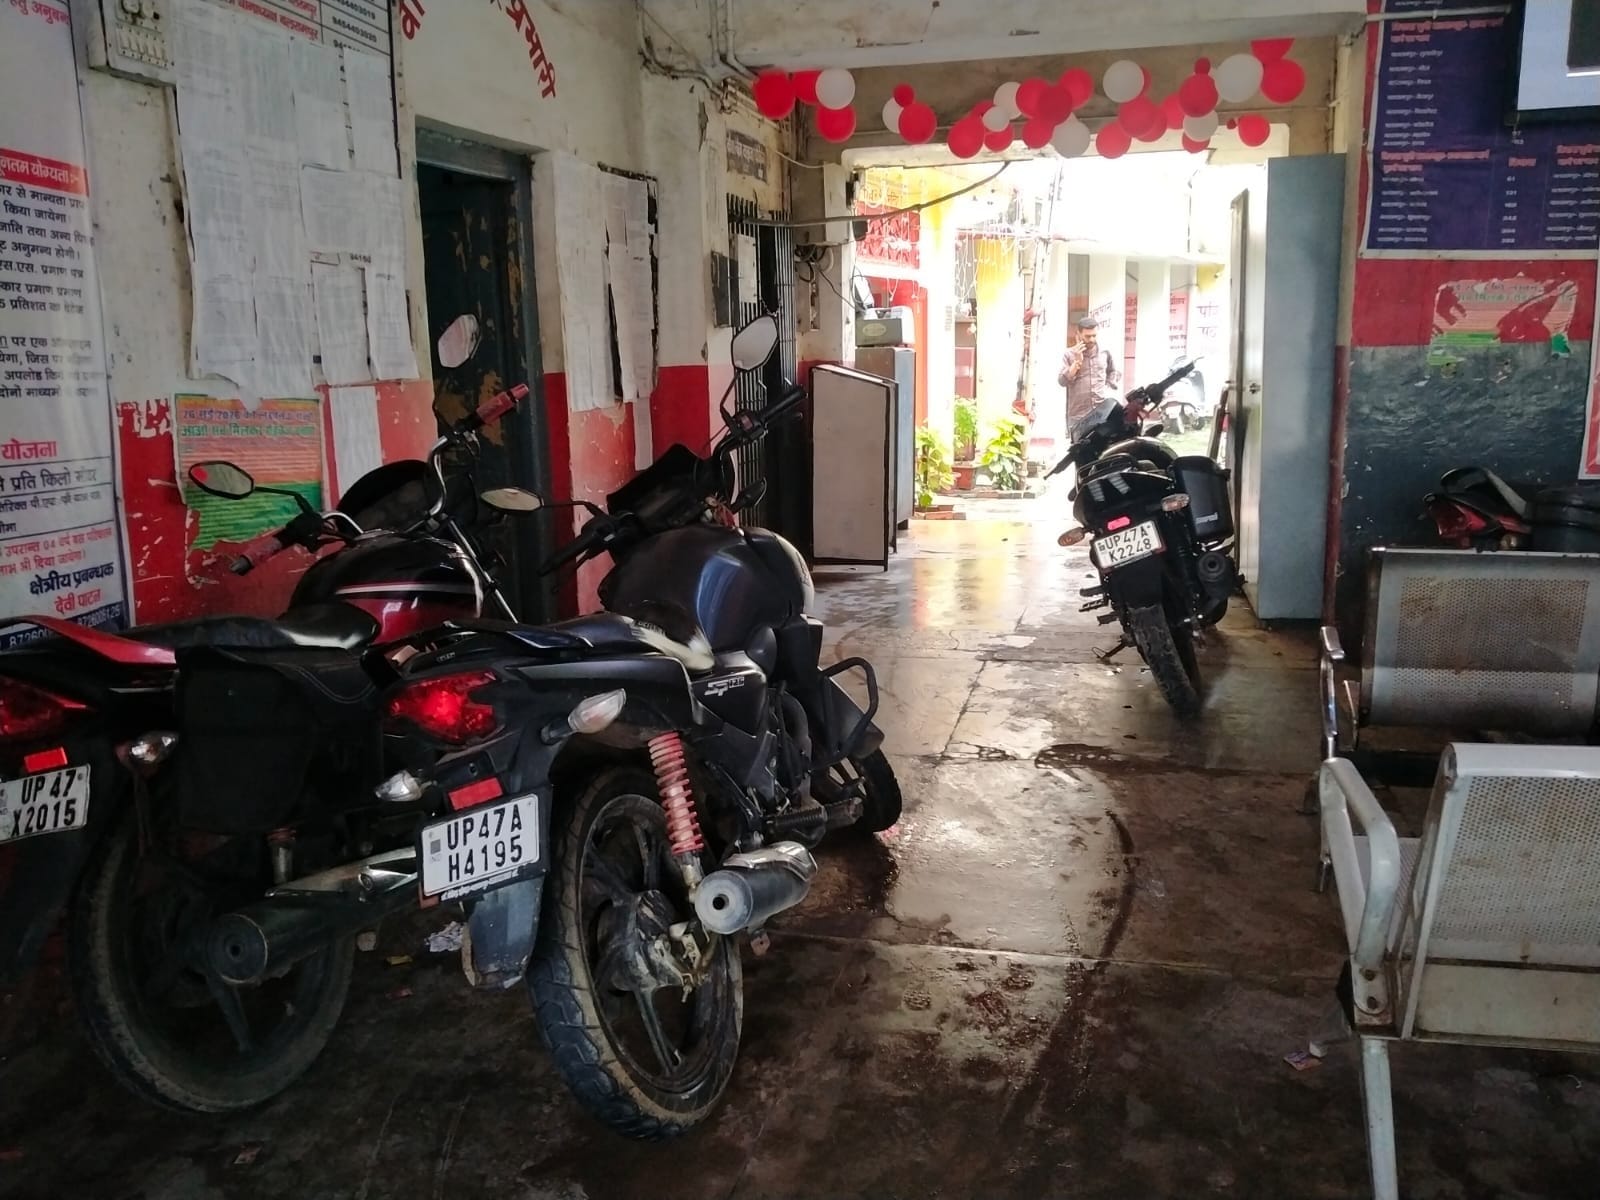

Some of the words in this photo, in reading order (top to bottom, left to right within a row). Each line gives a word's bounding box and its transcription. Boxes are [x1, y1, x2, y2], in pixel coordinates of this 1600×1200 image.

[15, 184, 26, 198] से
[29, 190, 66, 206] मान्यता
[3, 199, 31, 217] किया
[34, 208, 66, 223] जायेगा
[26, 225, 46, 238] तथा
[10, 296, 46, 311] प्रतिशत
[11, 336, 26, 346] पर
[26, 350, 49, 364] जिस
[1, 438, 57, 460] योजना
[10, 470, 36, 491] प्रति
[41, 467, 71, 487] किलो
[29, 570, 71, 596] क्षेत्रीय
[73, 561, 114, 589] प्रबन्धक
[55, 592, 76, 615] देवी
[78, 588, 102, 607] पाटन
[11, 798, 77, 839] X2015
[448, 835, 523, 883] H4195
